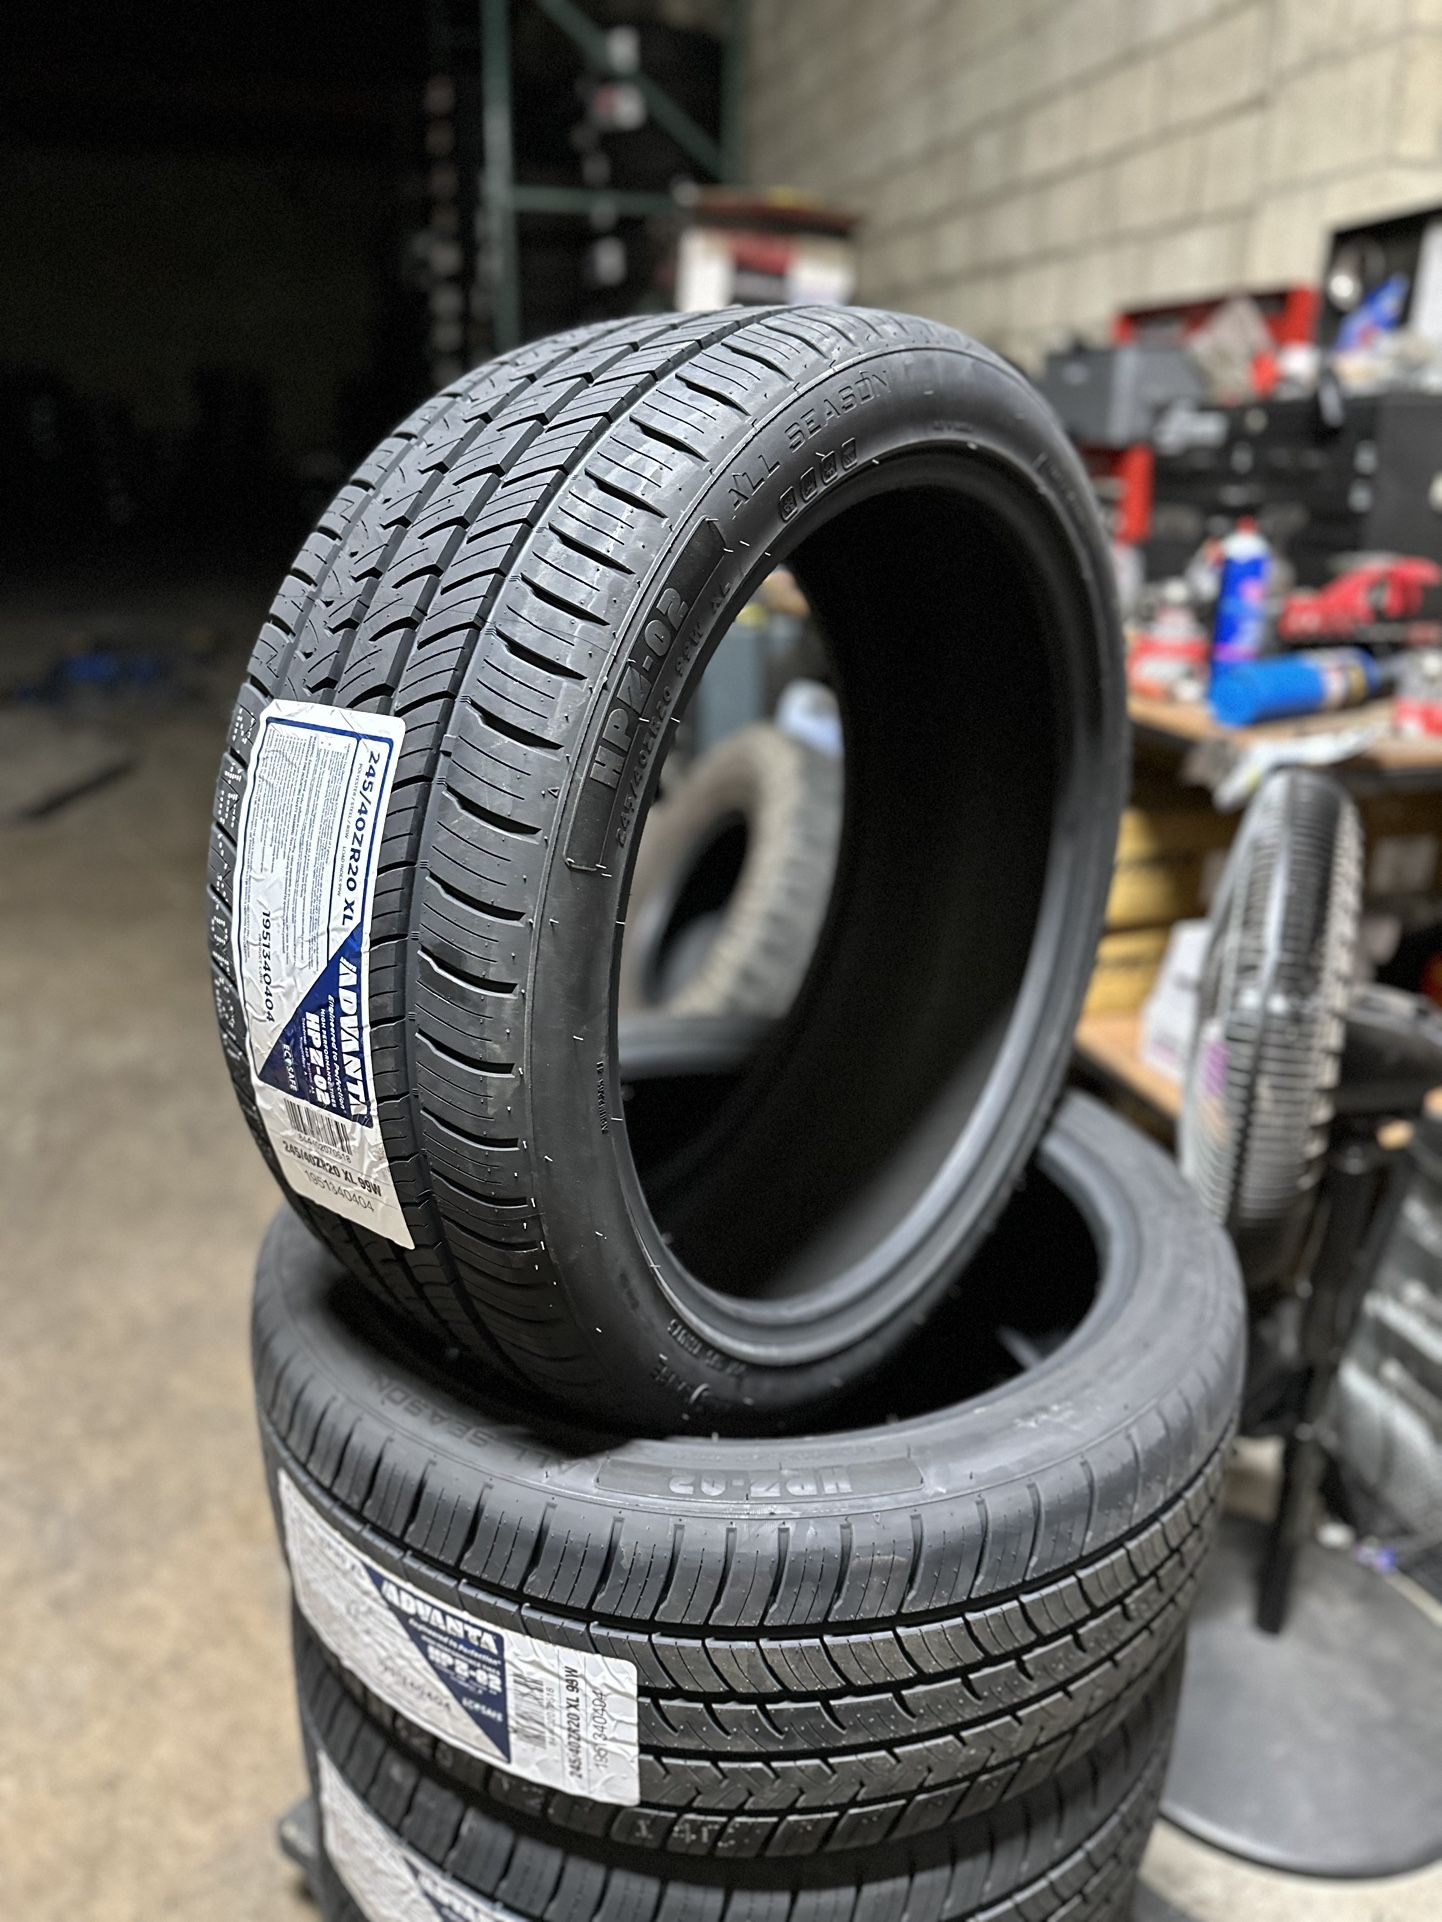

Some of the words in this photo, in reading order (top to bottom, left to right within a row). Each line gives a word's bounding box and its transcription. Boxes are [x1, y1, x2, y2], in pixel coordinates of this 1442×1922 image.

[727, 454, 781, 521] ALL
[785, 370, 892, 454] SEASON
[590, 587, 690, 790] HPZ-02
[346, 751, 381, 891] 245/40ZR20
[342, 898, 356, 926] XL
[262, 911, 275, 1022] 1951340404
[305, 1012, 331, 1106] HPZ-02
[322, 1029, 333, 1087] PERFORMANCE
[328, 994, 339, 1052] Engineered
[334, 1063, 345, 1110] Perfection
[339, 957, 368, 1116] ADVANTA
[304, 1170, 375, 1212] 1951340404
[341, 1169, 357, 1185] XL
[357, 1176, 382, 1197] 99W
[668, 1464, 853, 1497] HPZ-02
[381, 1580, 499, 1655] ADVANTA
[565, 1666, 580, 1693] 99W
[566, 1697, 580, 1711] XL
